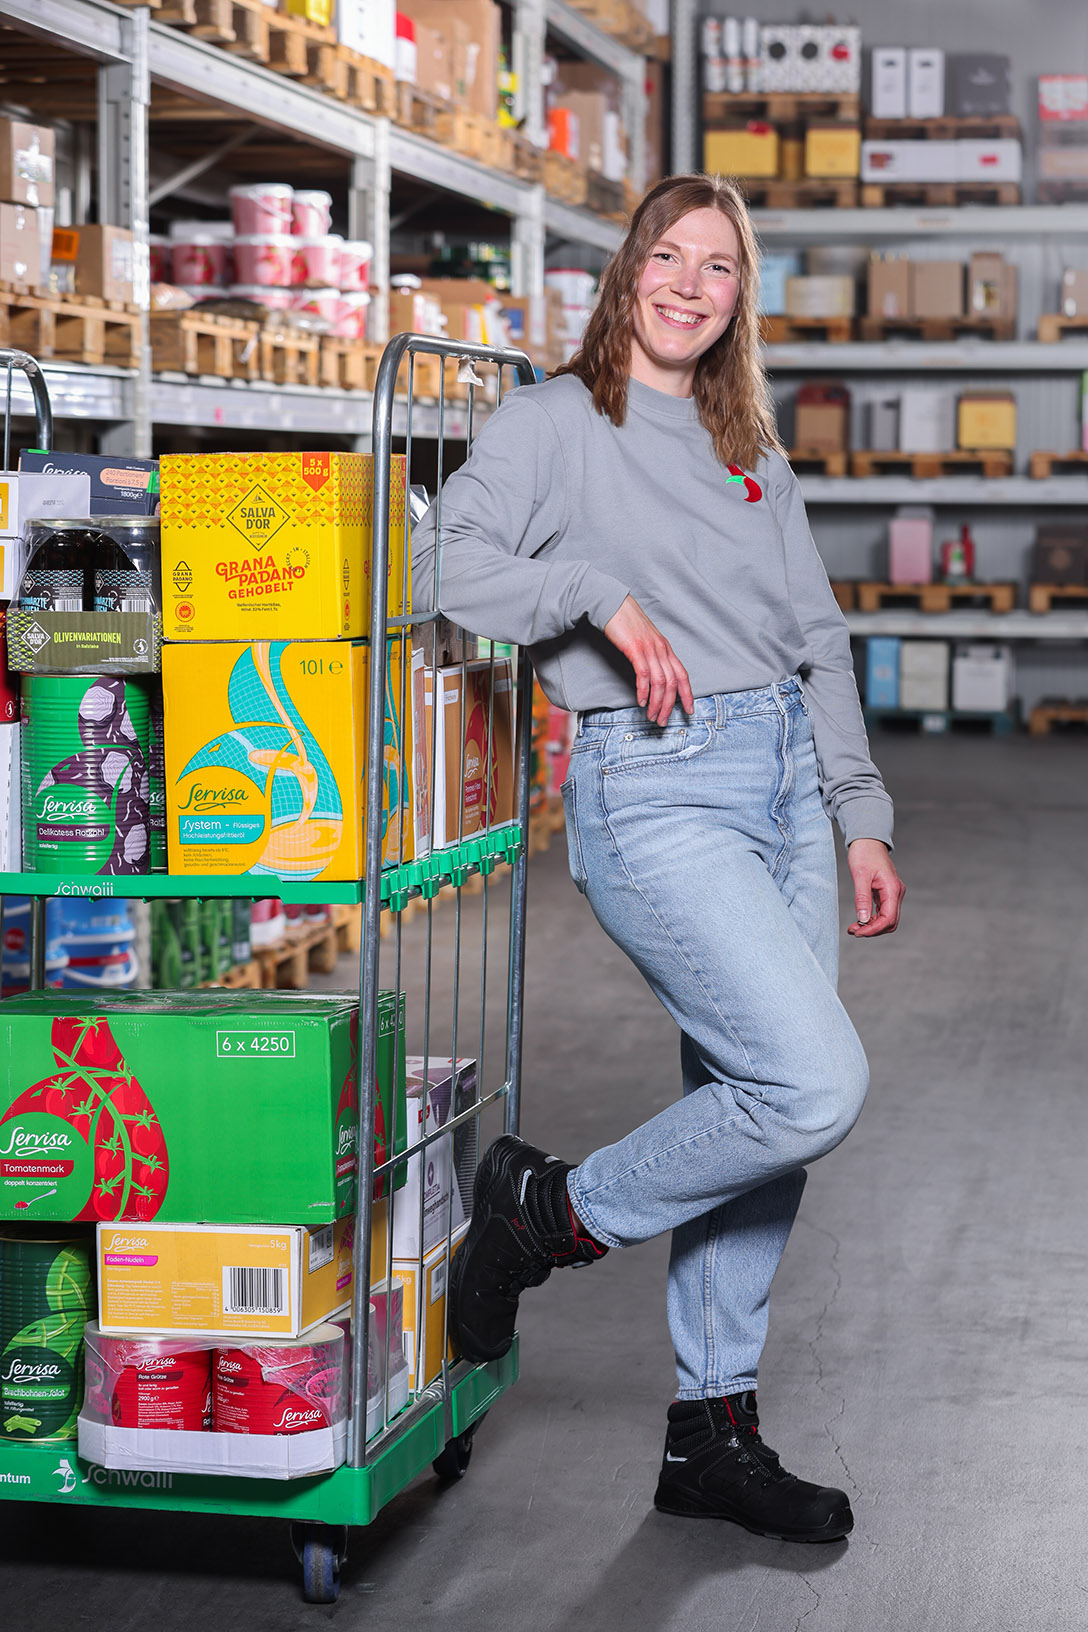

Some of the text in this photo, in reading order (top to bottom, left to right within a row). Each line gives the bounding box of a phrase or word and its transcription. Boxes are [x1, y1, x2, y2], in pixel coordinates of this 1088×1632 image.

[310, 459, 316, 467] 5
[303, 467, 329, 477] 500 g
[240, 507, 276, 519] SALVA
[246, 518, 271, 529] D'OR
[215, 555, 276, 582] GRANA
[238, 565, 306, 587] PADANO
[228, 581, 294, 600] GEHOBELT
[54, 631, 122, 645] OLIVENVARIATIONEN
[177, 783, 249, 812] Servisa
[36, 795, 97, 821] Servisa
[39, 828, 105, 837] Delikatess Rotkohl
[182, 820, 222, 833] System
[232, 821, 260, 829] Flüssiges
[222, 1036, 290, 1052] 6 x 4250
[0, 1126, 72, 1157] Servisa
[4, 1163, 65, 1173] Tomatenmark
[104, 1233, 149, 1252] Servisa
[106, 1256, 145, 1264] Faden-Nudeln
[1, 1359, 61, 1383] Servisa
[217, 1356, 243, 1373] Servisa
[4, 1387, 65, 1397] Brechbohnen-Salat
[273, 1407, 323, 1429] Servisa
